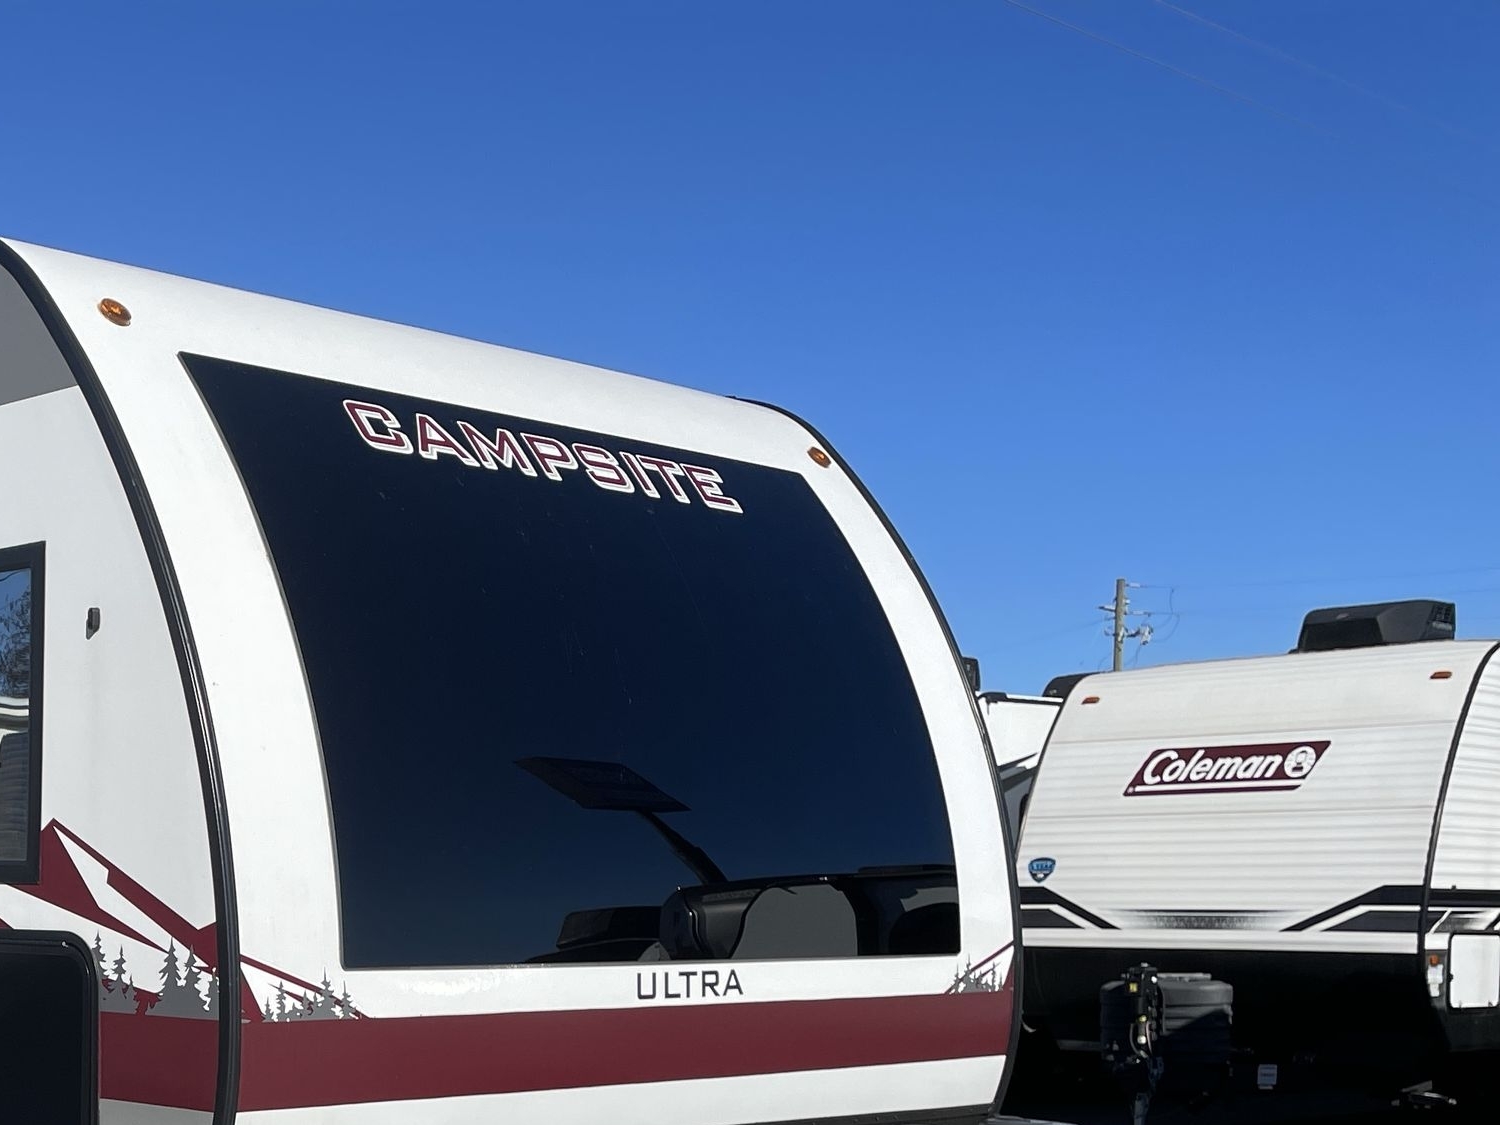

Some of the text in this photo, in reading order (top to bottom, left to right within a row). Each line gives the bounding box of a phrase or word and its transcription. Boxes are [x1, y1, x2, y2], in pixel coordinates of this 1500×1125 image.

[343, 399, 744, 514] CAMPSITE
[1143, 749, 1283, 785] Coleman
[637, 969, 744, 1000] ULTRA
